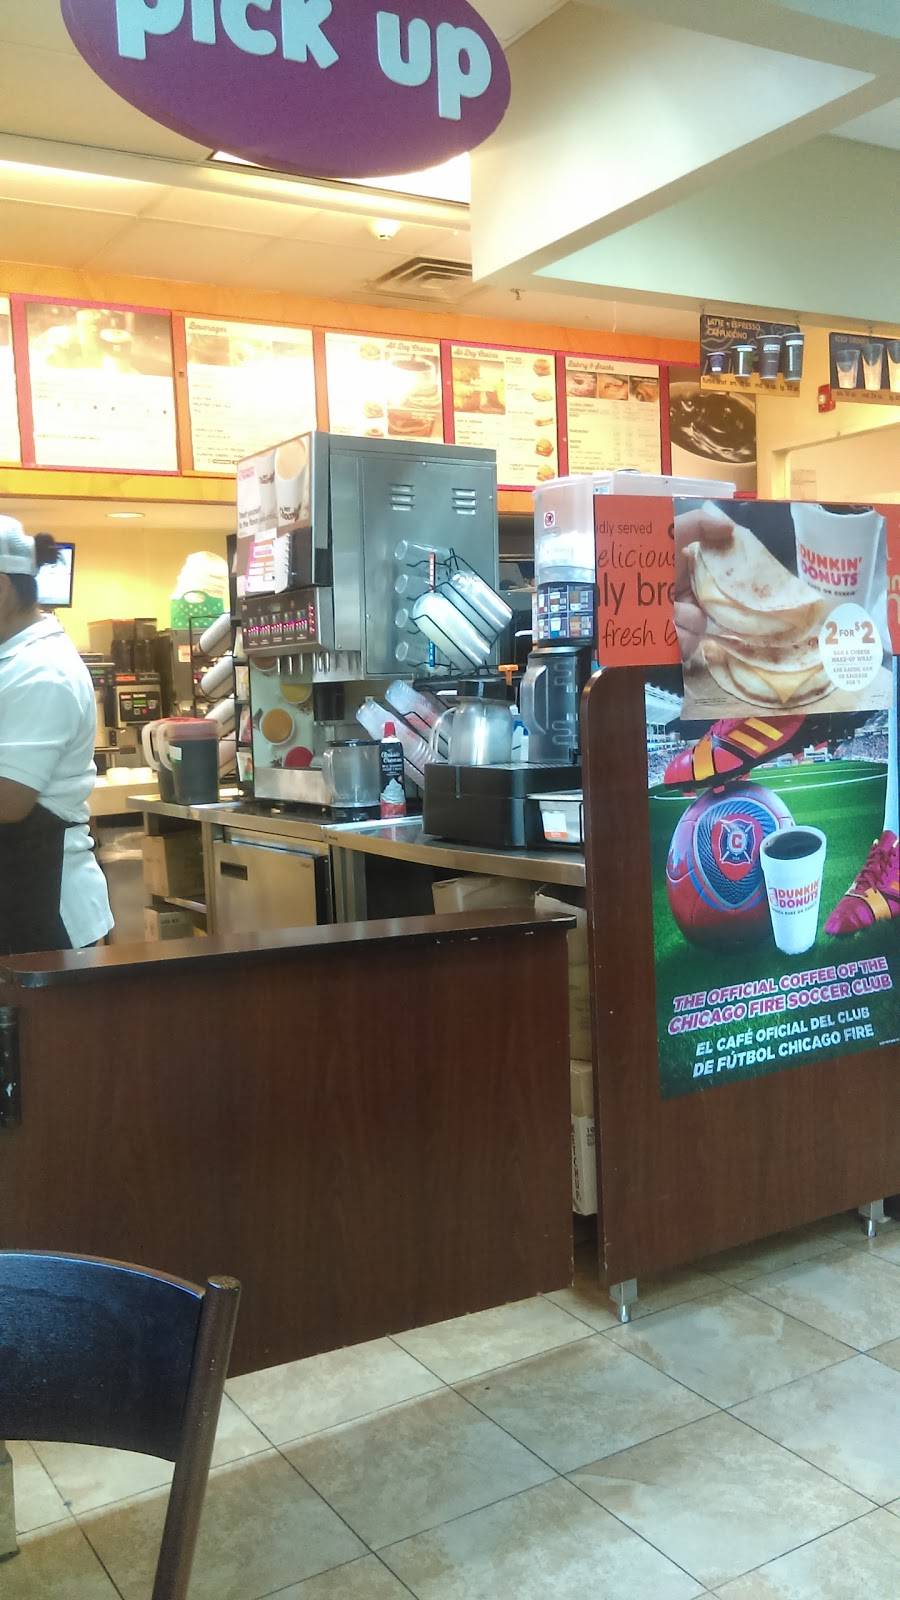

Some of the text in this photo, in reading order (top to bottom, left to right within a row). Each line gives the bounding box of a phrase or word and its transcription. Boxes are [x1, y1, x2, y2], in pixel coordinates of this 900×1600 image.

[115, 0, 493, 121] pick up
[596, 520, 614, 536] dly
[617, 520, 653, 535] served
[800, 544, 863, 571] DUNKIN'
[801, 560, 859, 587] DONUTS
[602, 619, 656, 648] fresh
[825, 621, 839, 645] 2
[839, 629, 855, 638] FOR
[673, 956, 888, 1013] THE OFFICIAL COFFEE OF THE
[668, 974, 892, 1036] CHICAGO FIRE SOCCER CLUB
[693, 1023, 875, 1078] DE FÚTBOL CHICAGO FIRE
[696, 1006, 870, 1056] EL CAFÉ OFICIAL DEL CLUB
